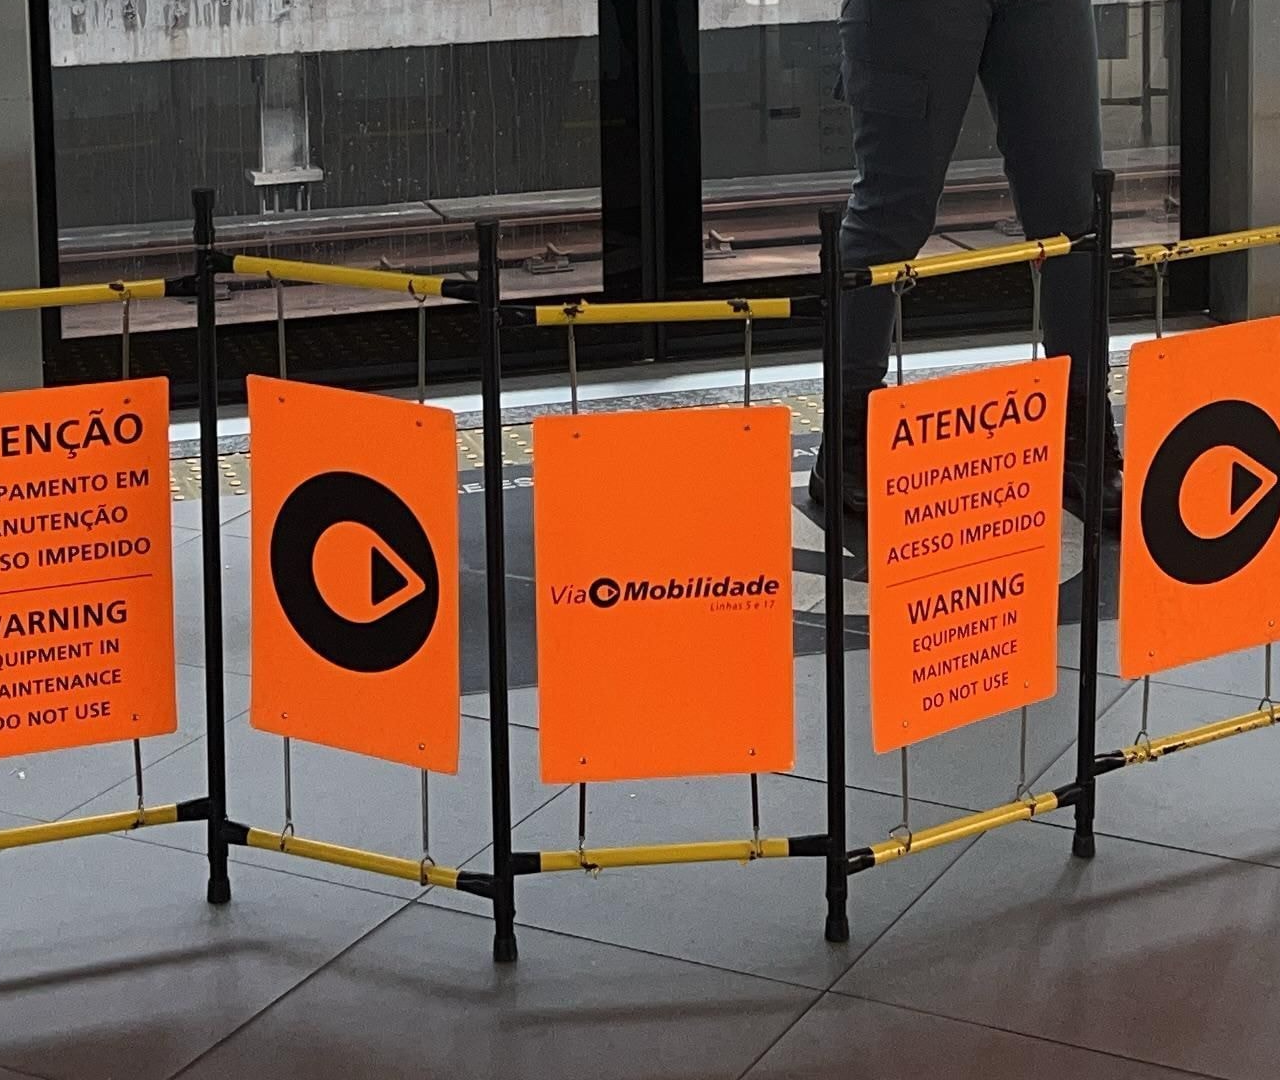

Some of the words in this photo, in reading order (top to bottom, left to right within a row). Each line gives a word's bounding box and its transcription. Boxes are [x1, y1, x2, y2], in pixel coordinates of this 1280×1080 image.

[891, 389, 1047, 451] ATENÇÃO
[116, 469, 149, 488] EM
[886, 451, 1016, 496] EQUIPAMENTO
[1023, 445, 1049, 465] EM
[904, 481, 1030, 526] MANUTENÇÃO
[38, 536, 151, 567] IMPEDIDO
[887, 532, 953, 565] ACESSO
[960, 510, 1046, 546] IMPEDIDO
[550, 584, 586, 605] Via
[623, 575, 780, 601] Mobilidade
[907, 573, 1025, 625] WARNING
[100, 638, 120, 655] IN
[28, 707, 69, 727] NOT
[75, 701, 111, 720] USE
